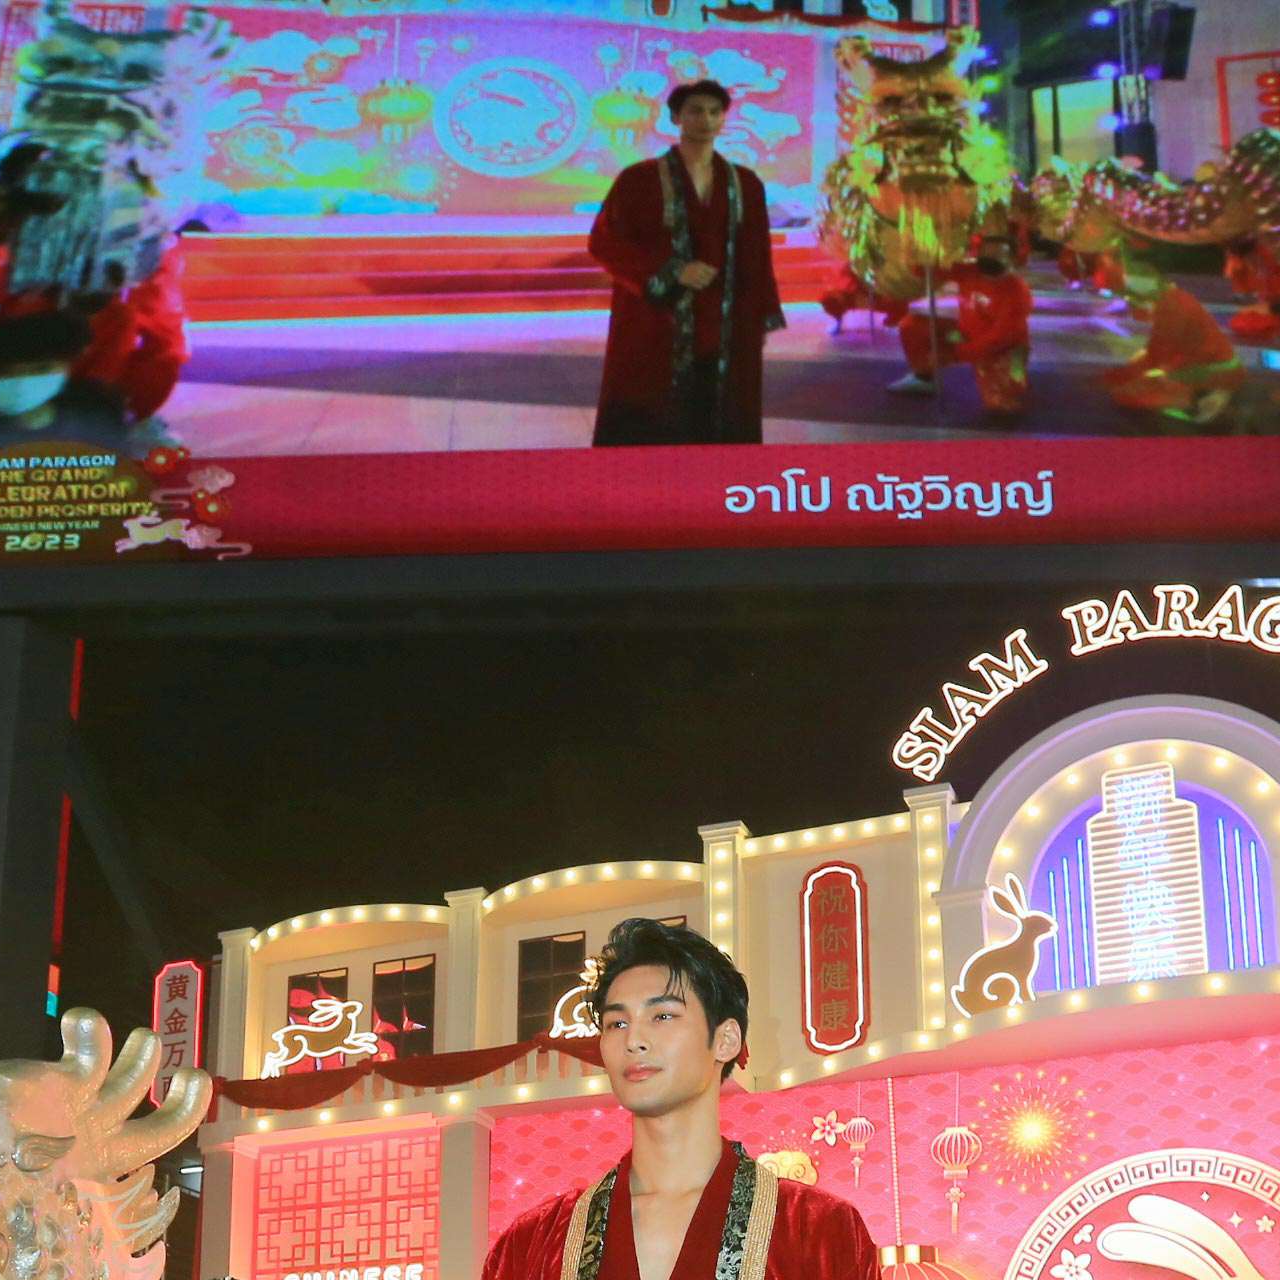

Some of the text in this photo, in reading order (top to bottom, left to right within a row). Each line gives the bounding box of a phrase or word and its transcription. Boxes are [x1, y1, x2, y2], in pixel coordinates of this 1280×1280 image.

[29, 455, 116, 468] PARAGON
[31, 468, 102, 481] GRAND
[724, 467, 1054, 520] อาโป ณัฐวิญญ์
[37, 501, 154, 518] PROSPERITY
[67, 519, 100, 530] YEAR
[4, 533, 80, 552] 2023
[893, 628, 1048, 782] SIAM
[818, 884, 850, 1032] 祝你健康
